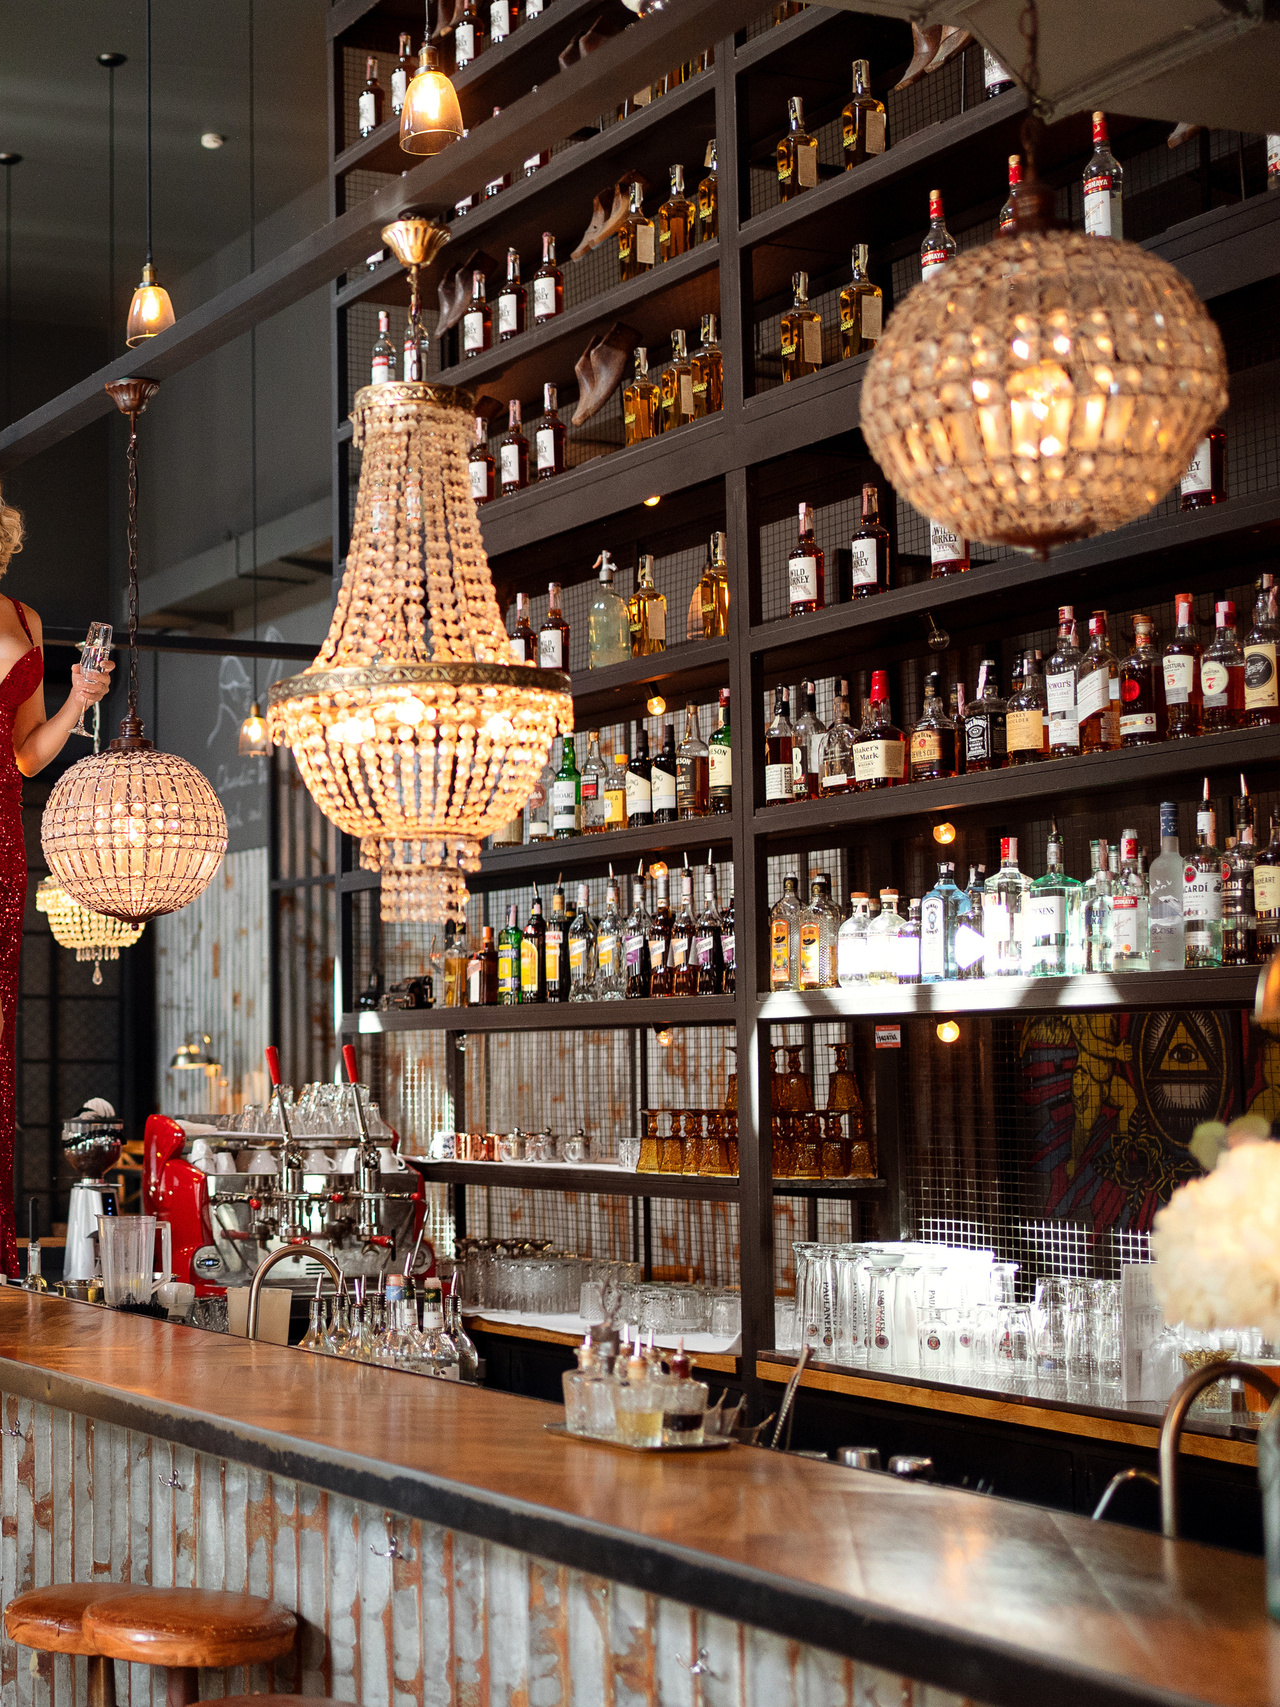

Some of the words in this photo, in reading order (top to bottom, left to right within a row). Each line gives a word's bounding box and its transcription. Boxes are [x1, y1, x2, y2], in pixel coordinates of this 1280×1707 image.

[934, 526, 948, 536] WIL
[1167, 674, 1175, 685] 5
[1206, 677, 1216, 689] 7
[1144, 715, 1154, 725] 8
[859, 752, 879, 761] Mark
[823, 1281, 832, 1333] PAULANER
